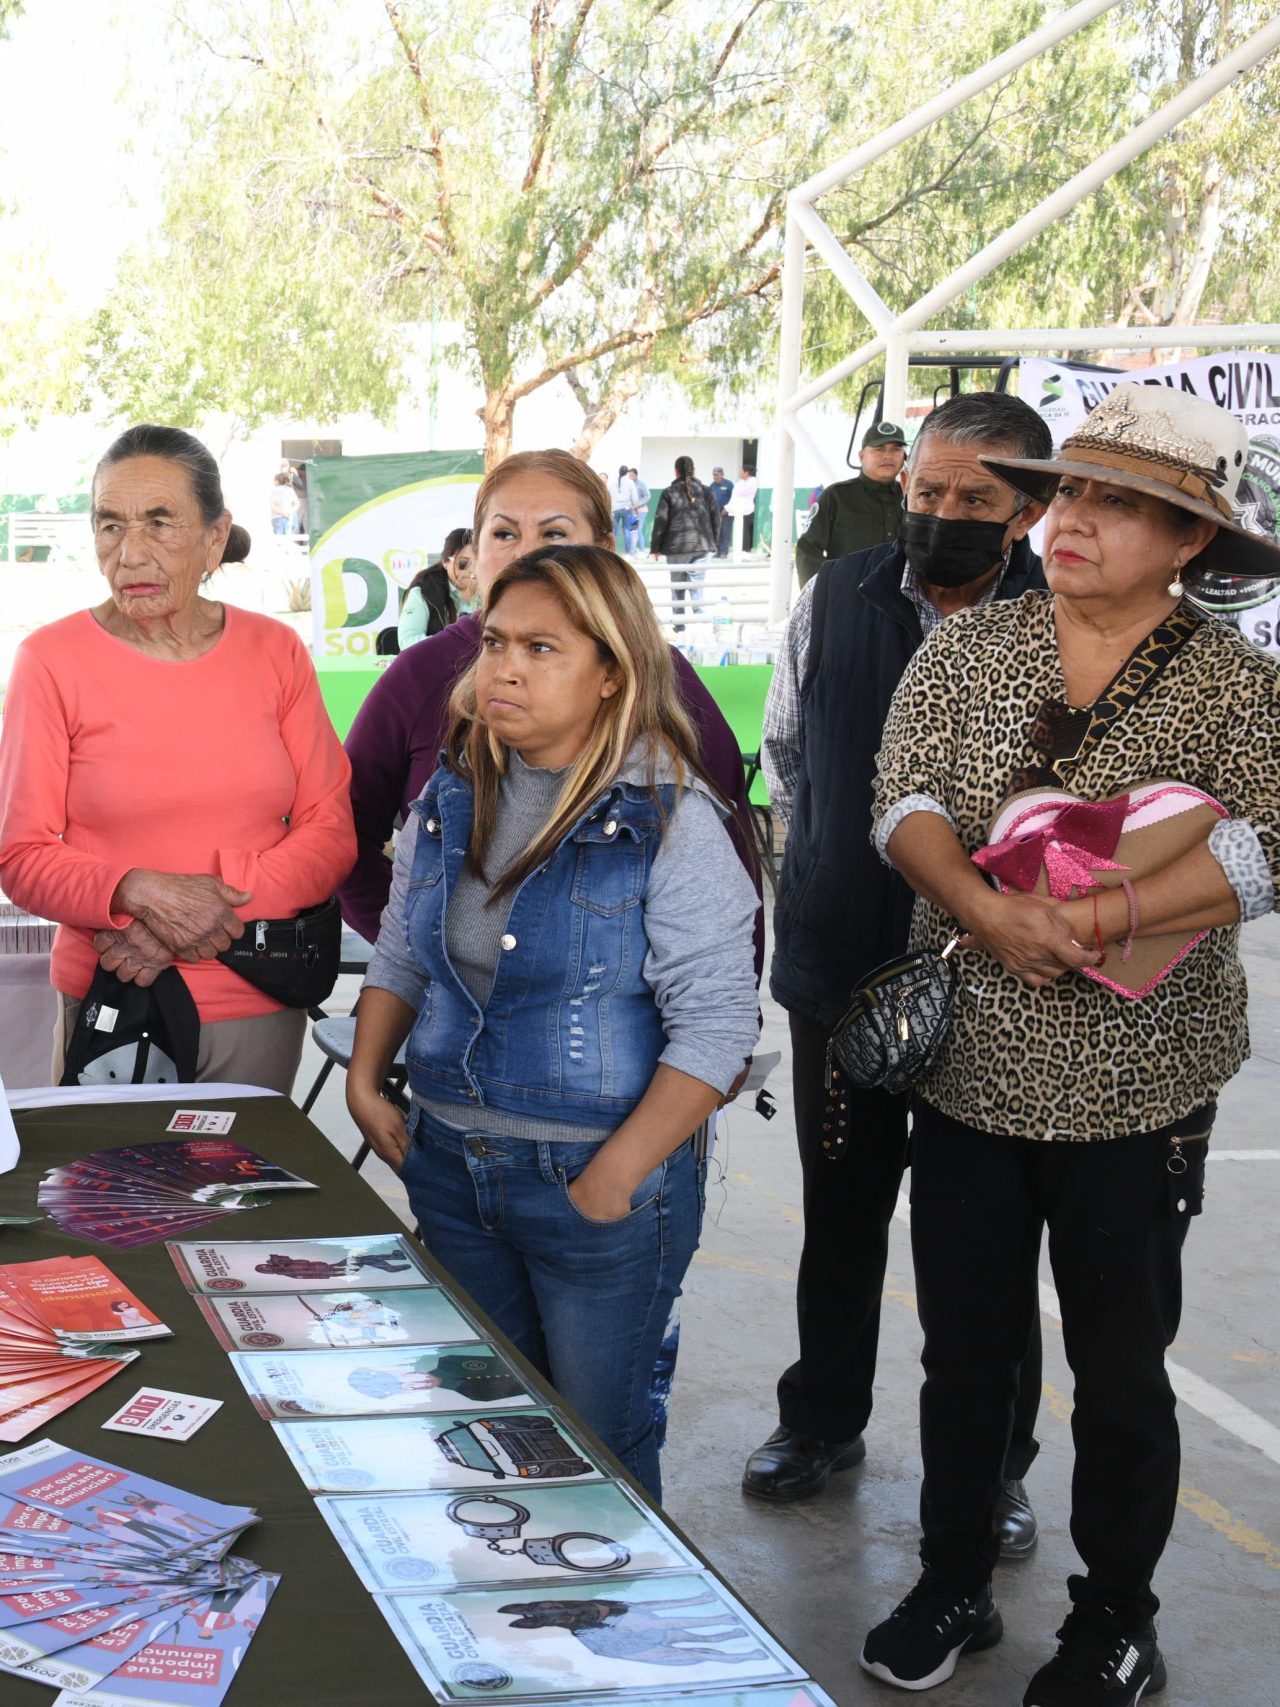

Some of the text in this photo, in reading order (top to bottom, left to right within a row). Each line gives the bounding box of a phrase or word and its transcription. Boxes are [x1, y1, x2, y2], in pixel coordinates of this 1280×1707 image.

[1205, 587, 1237, 596] LEALTAD
[196, 1249, 218, 1277] GUARDIA
[227, 1301, 254, 1332] GUARDIA
[120, 1399, 160, 1424] 911
[147, 1401, 182, 1431] EMERGENCIAS
[27, 1465, 94, 1498] ¿Por qué es
[38, 1469, 105, 1502] importante
[54, 1472, 118, 1506] denunciar?
[13, 1510, 29, 1529] ¿Por
[356, 1506, 398, 1555] GUARDIA
[372, 1506, 410, 1554] CIVIL ESTATAL
[12, 1595, 43, 1612] ¿Por
[419, 1602, 466, 1660] GUARDIA
[435, 1601, 480, 1659] CIVIL ESTATAL
[126, 1664, 215, 1680] ¿Por qué
[1116, 1645, 1140, 1684] PUMA
